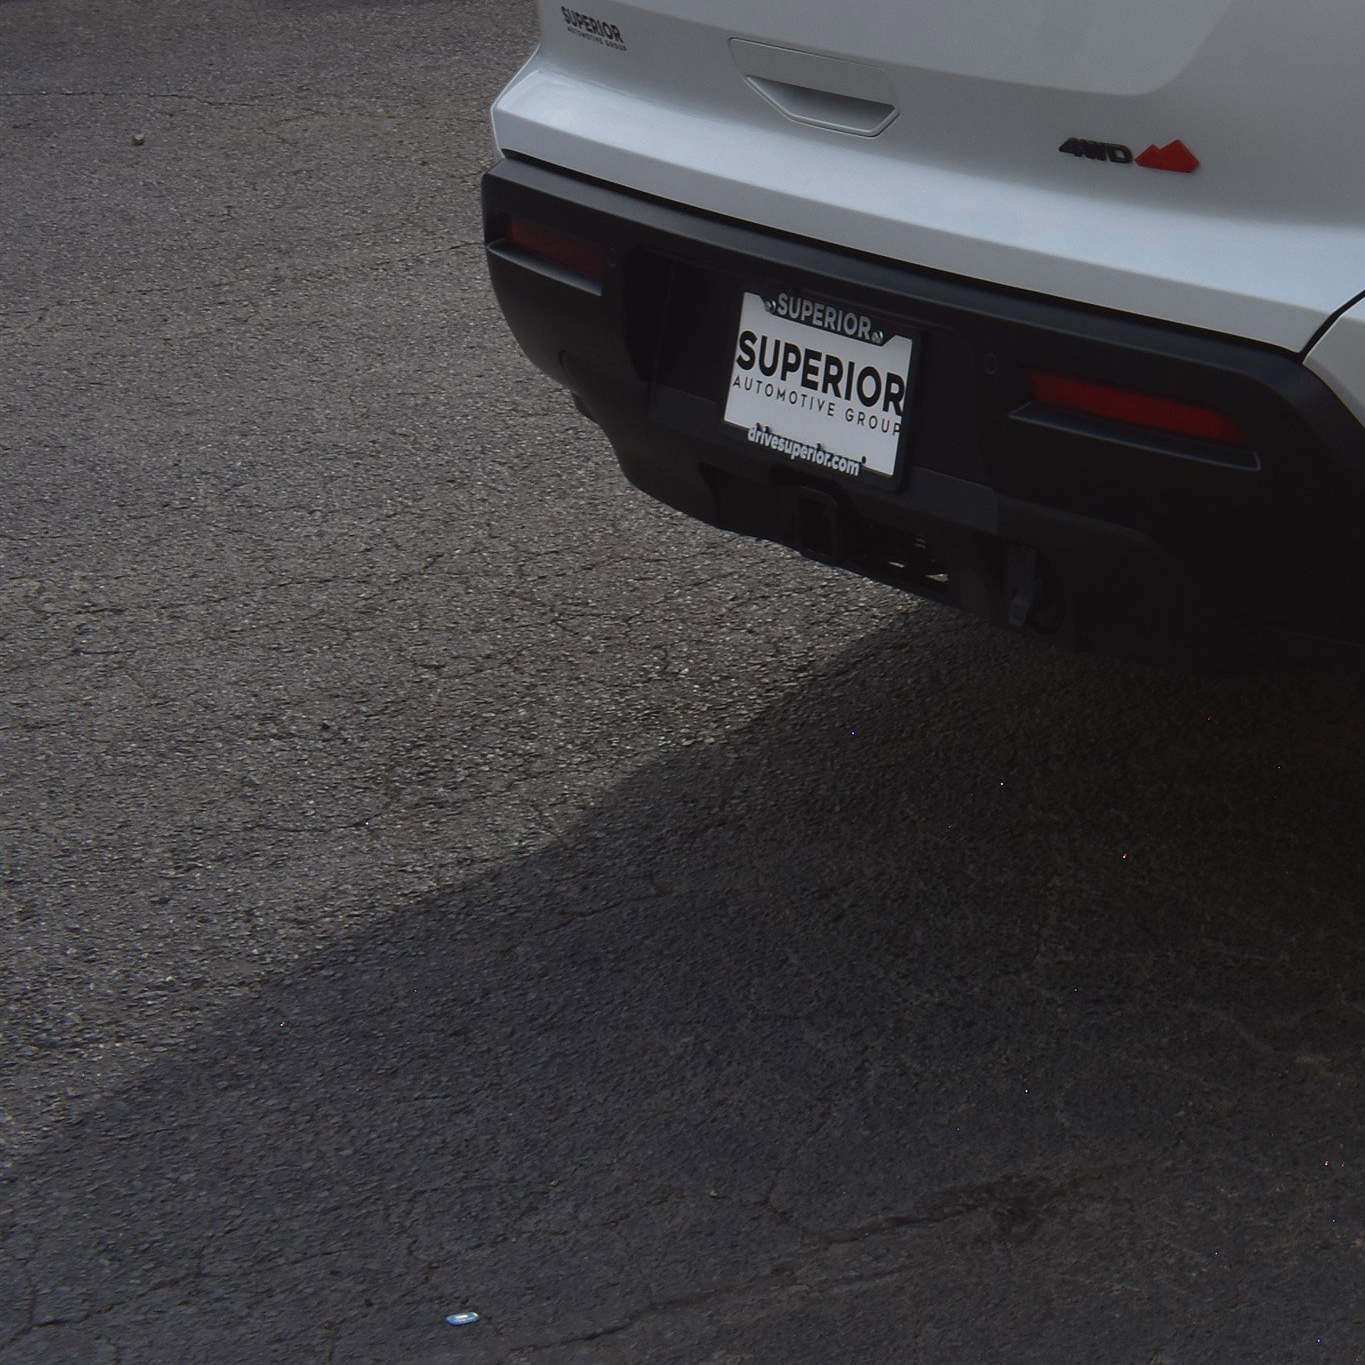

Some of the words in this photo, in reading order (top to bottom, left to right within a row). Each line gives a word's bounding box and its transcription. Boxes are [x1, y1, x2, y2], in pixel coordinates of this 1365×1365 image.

[561, 5, 624, 43] SUPERIOR
[1059, 137, 1133, 164] 4WD
[777, 292, 872, 341] SUPERIOR
[736, 330, 906, 416] SUPERIOR
[733, 375, 836, 417] AUTOMOTIVE
[845, 408, 901, 436] GROUP
[747, 424, 860, 477] drivesuperior.com
